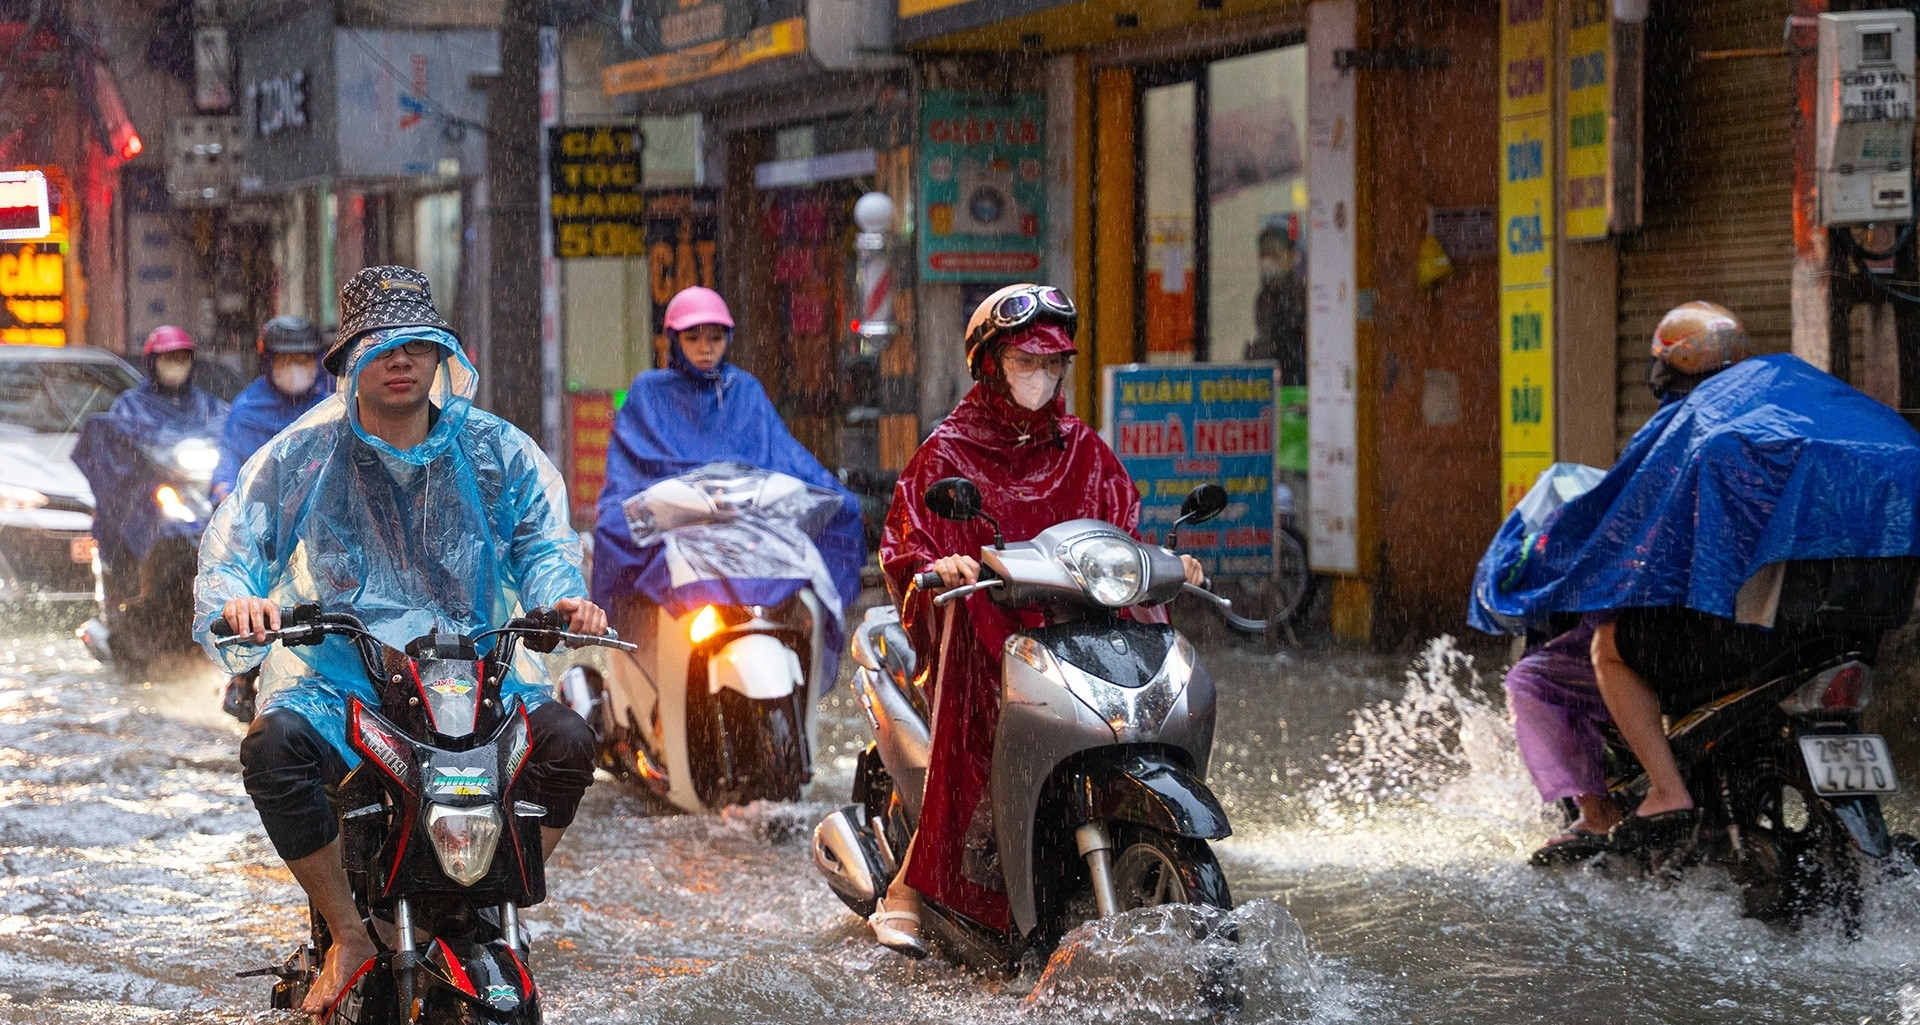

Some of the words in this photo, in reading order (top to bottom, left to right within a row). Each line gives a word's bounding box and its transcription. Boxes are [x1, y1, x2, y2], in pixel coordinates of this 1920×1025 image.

[1119, 413, 1186, 457] NHÀ
[1194, 406, 1273, 454] NGHỈ
[1826, 765, 1886, 790] 4270
